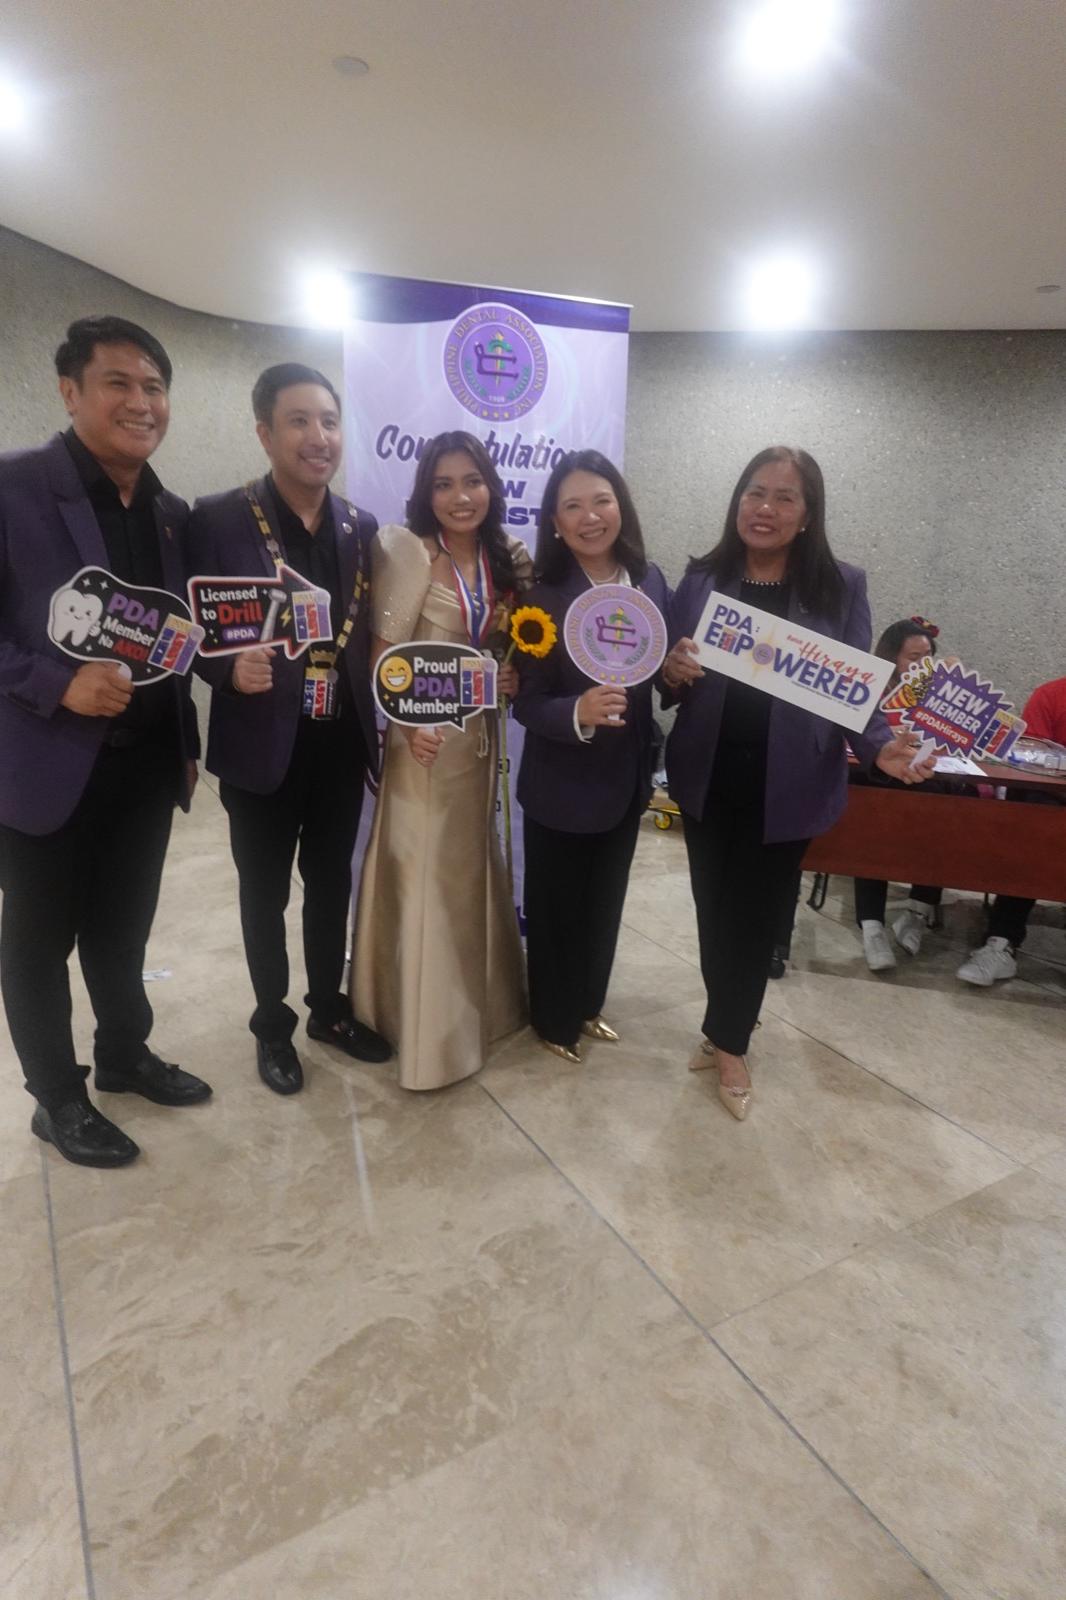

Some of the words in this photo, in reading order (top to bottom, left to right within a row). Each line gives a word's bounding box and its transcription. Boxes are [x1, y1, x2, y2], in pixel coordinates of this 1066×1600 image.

[200, 585, 258, 603] Licensed
[106, 591, 160, 631] PDA
[201, 607, 217, 621] to
[218, 603, 264, 624] Drill
[97, 633, 114, 649] Na
[102, 615, 156, 647] Member
[227, 626, 255, 639] #PDA
[413, 656, 457, 675] Proud
[414, 677, 457, 698] PDA
[936, 680, 990, 716] NEW
[399, 698, 460, 715] Member
[924, 696, 981, 734] MEMBER
[914, 710, 969, 745] #PDAHiraya
